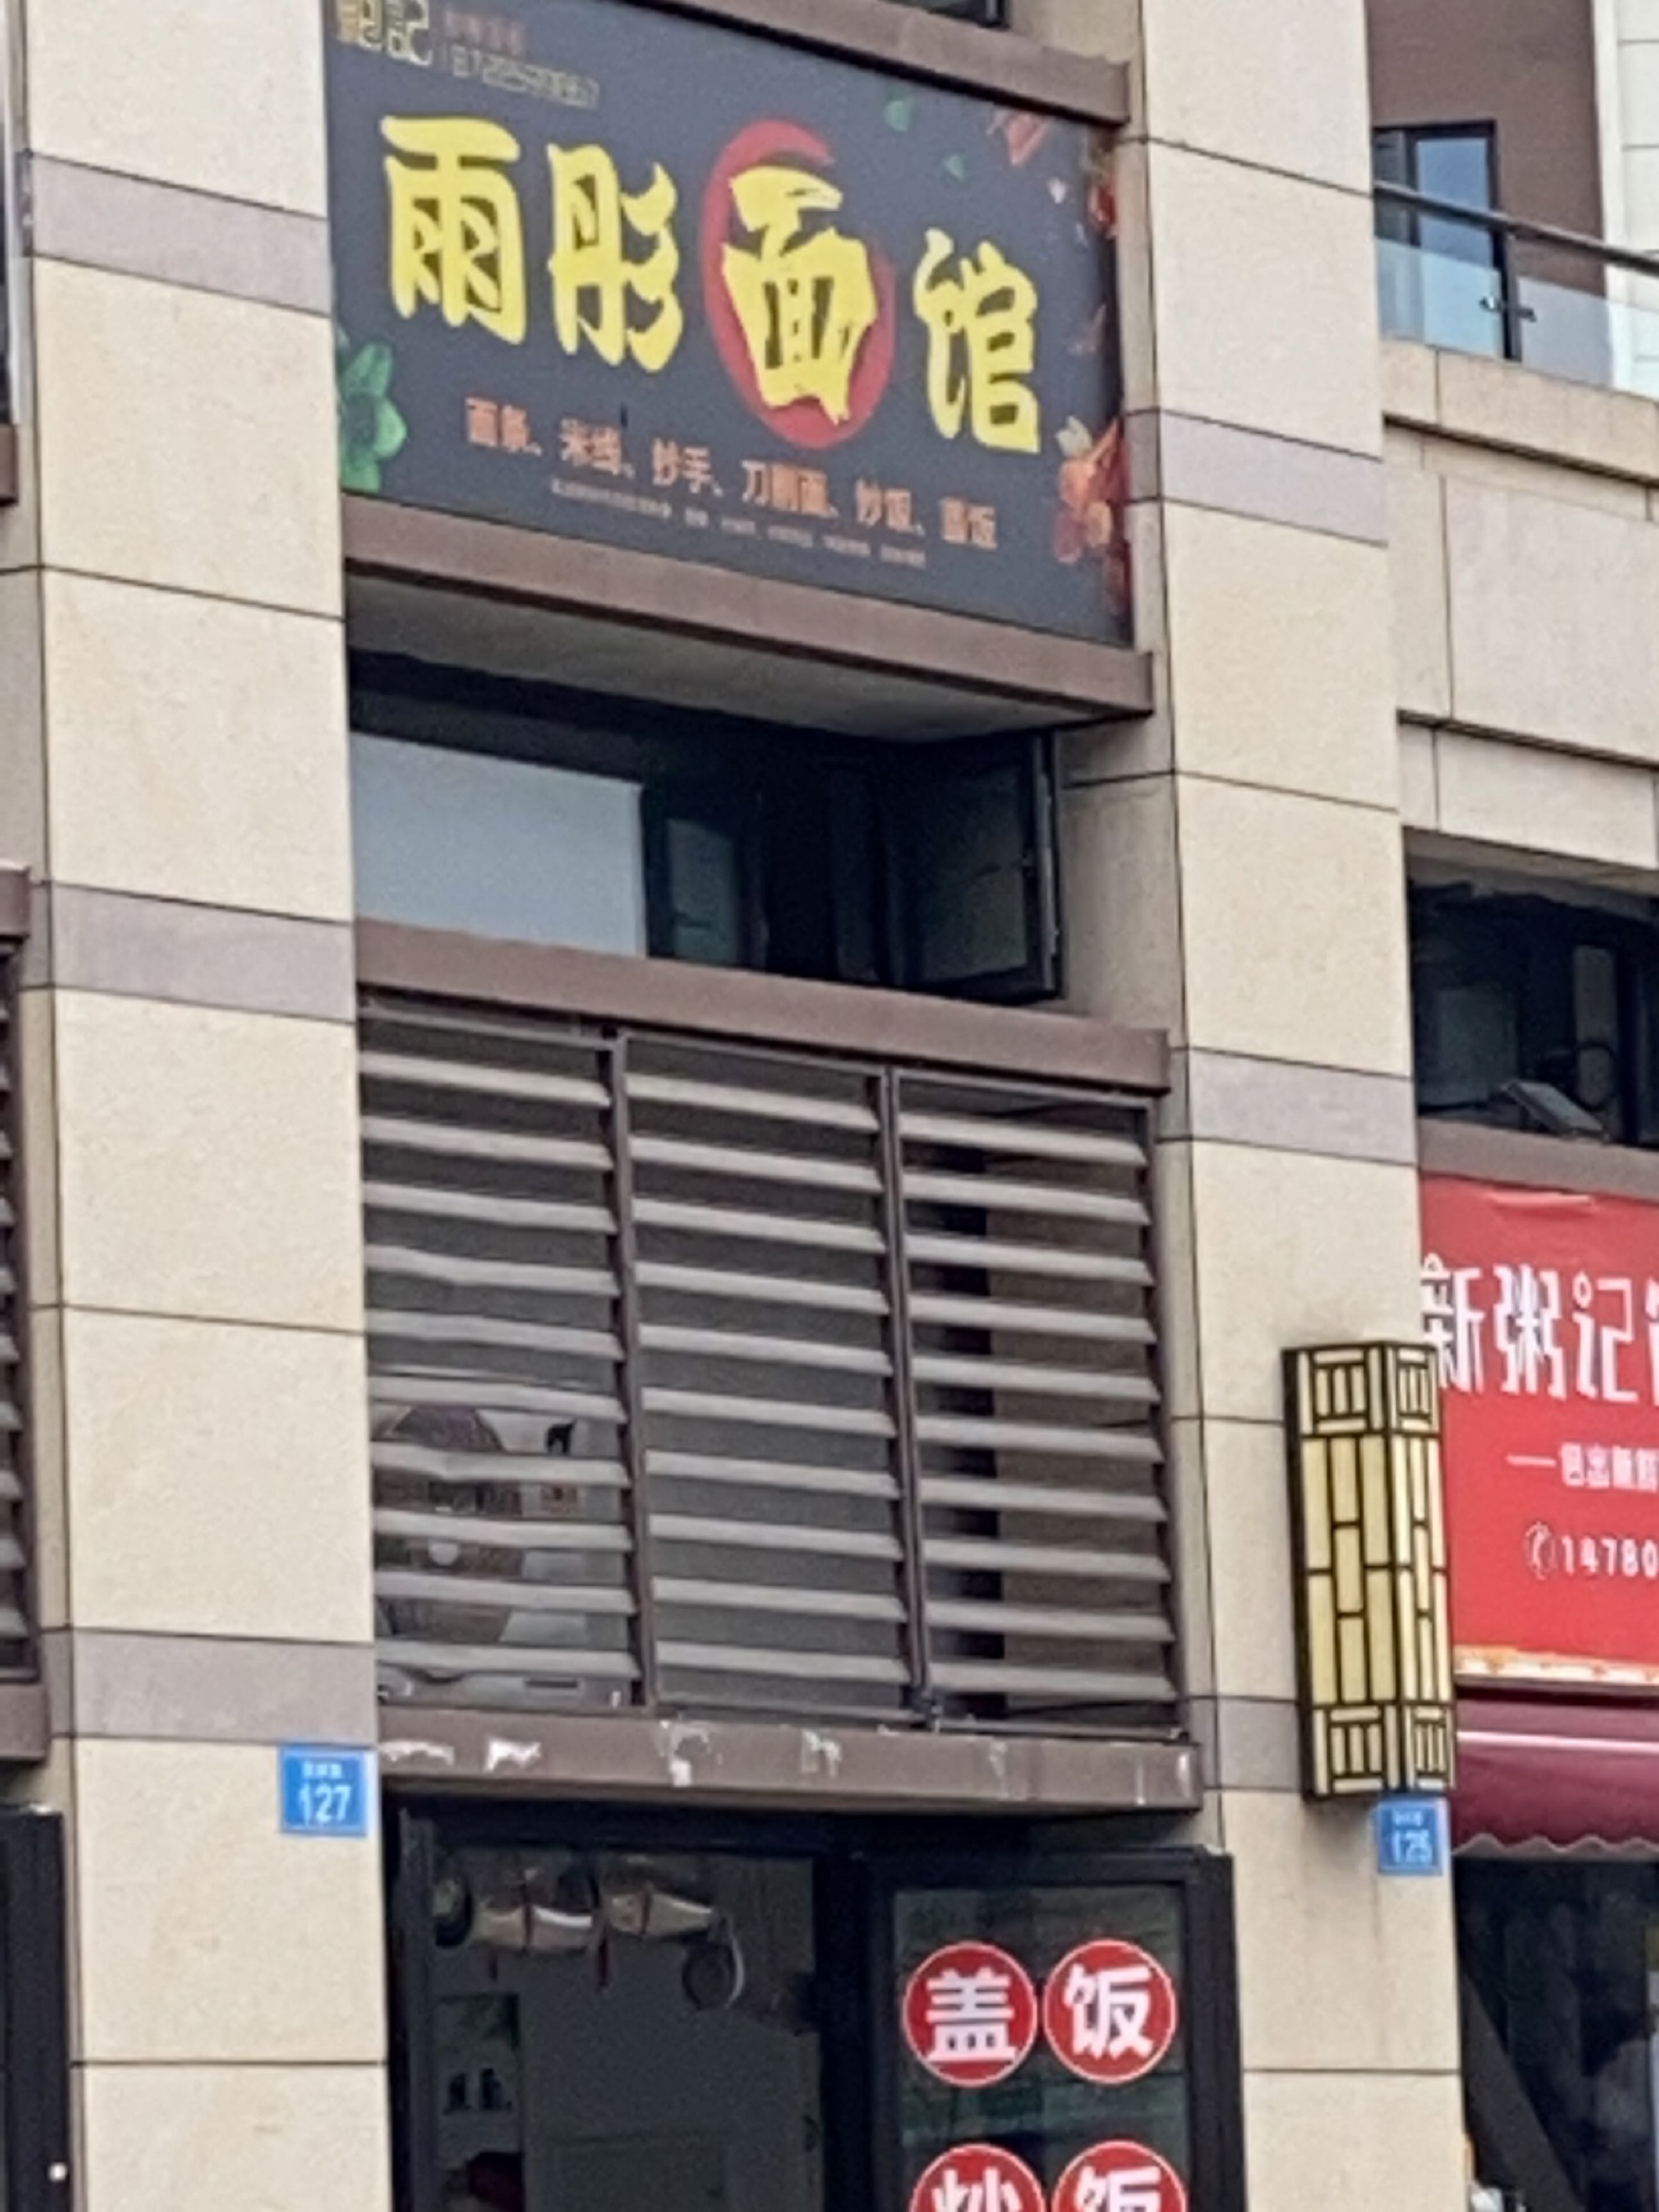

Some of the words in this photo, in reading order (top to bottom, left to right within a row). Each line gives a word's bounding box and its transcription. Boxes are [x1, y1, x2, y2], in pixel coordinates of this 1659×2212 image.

[380, 115, 1041, 454] 雨彤面馆
[299, 1783, 352, 1824] 127
[926, 1963, 1153, 2062] 盖饭
